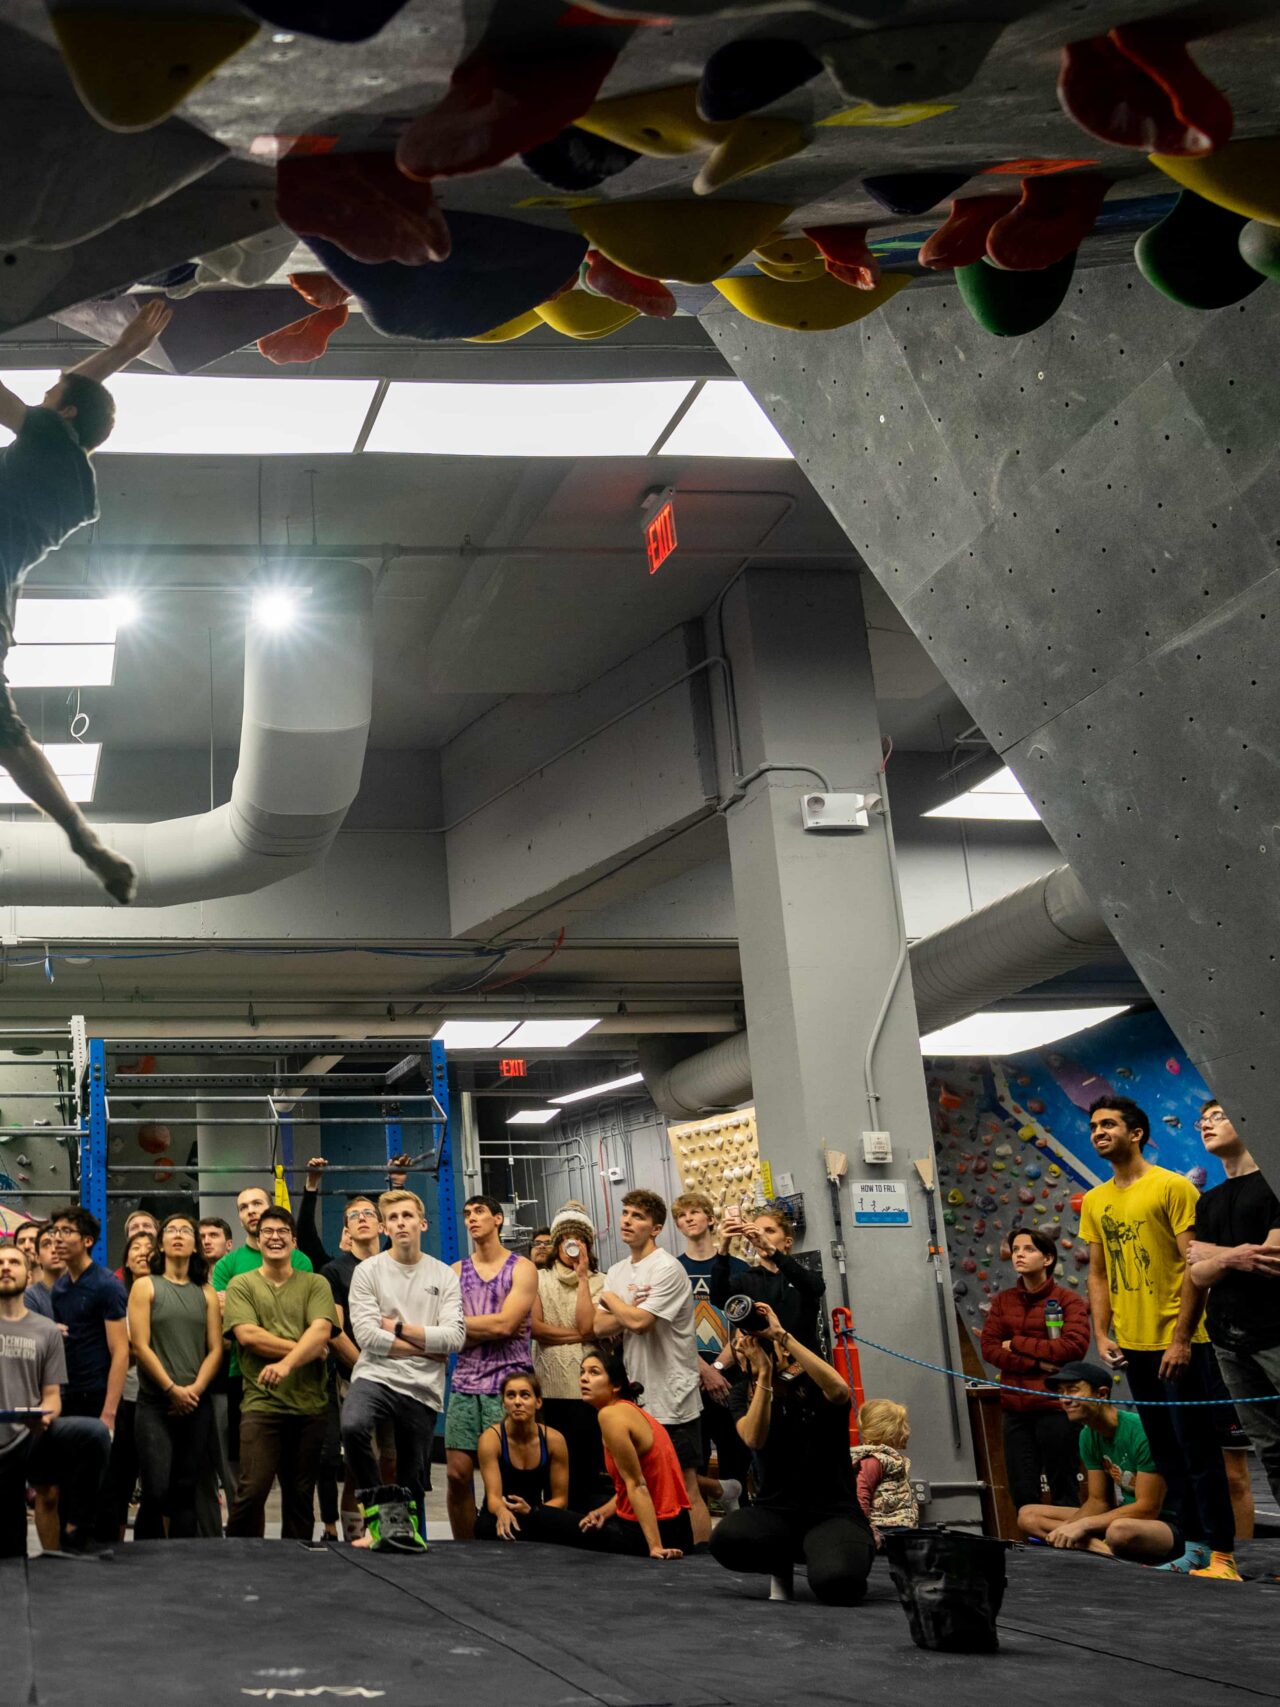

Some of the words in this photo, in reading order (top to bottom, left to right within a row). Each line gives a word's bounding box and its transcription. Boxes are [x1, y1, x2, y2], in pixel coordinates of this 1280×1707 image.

[649, 505, 674, 569] EXIT
[502, 1059, 524, 1077] EXIT
[860, 1184, 874, 1193] HOW
[875, 1184, 882, 1193] TO
[883, 1184, 897, 1193] FALL
[5, 1335, 36, 1349] CENTRAL
